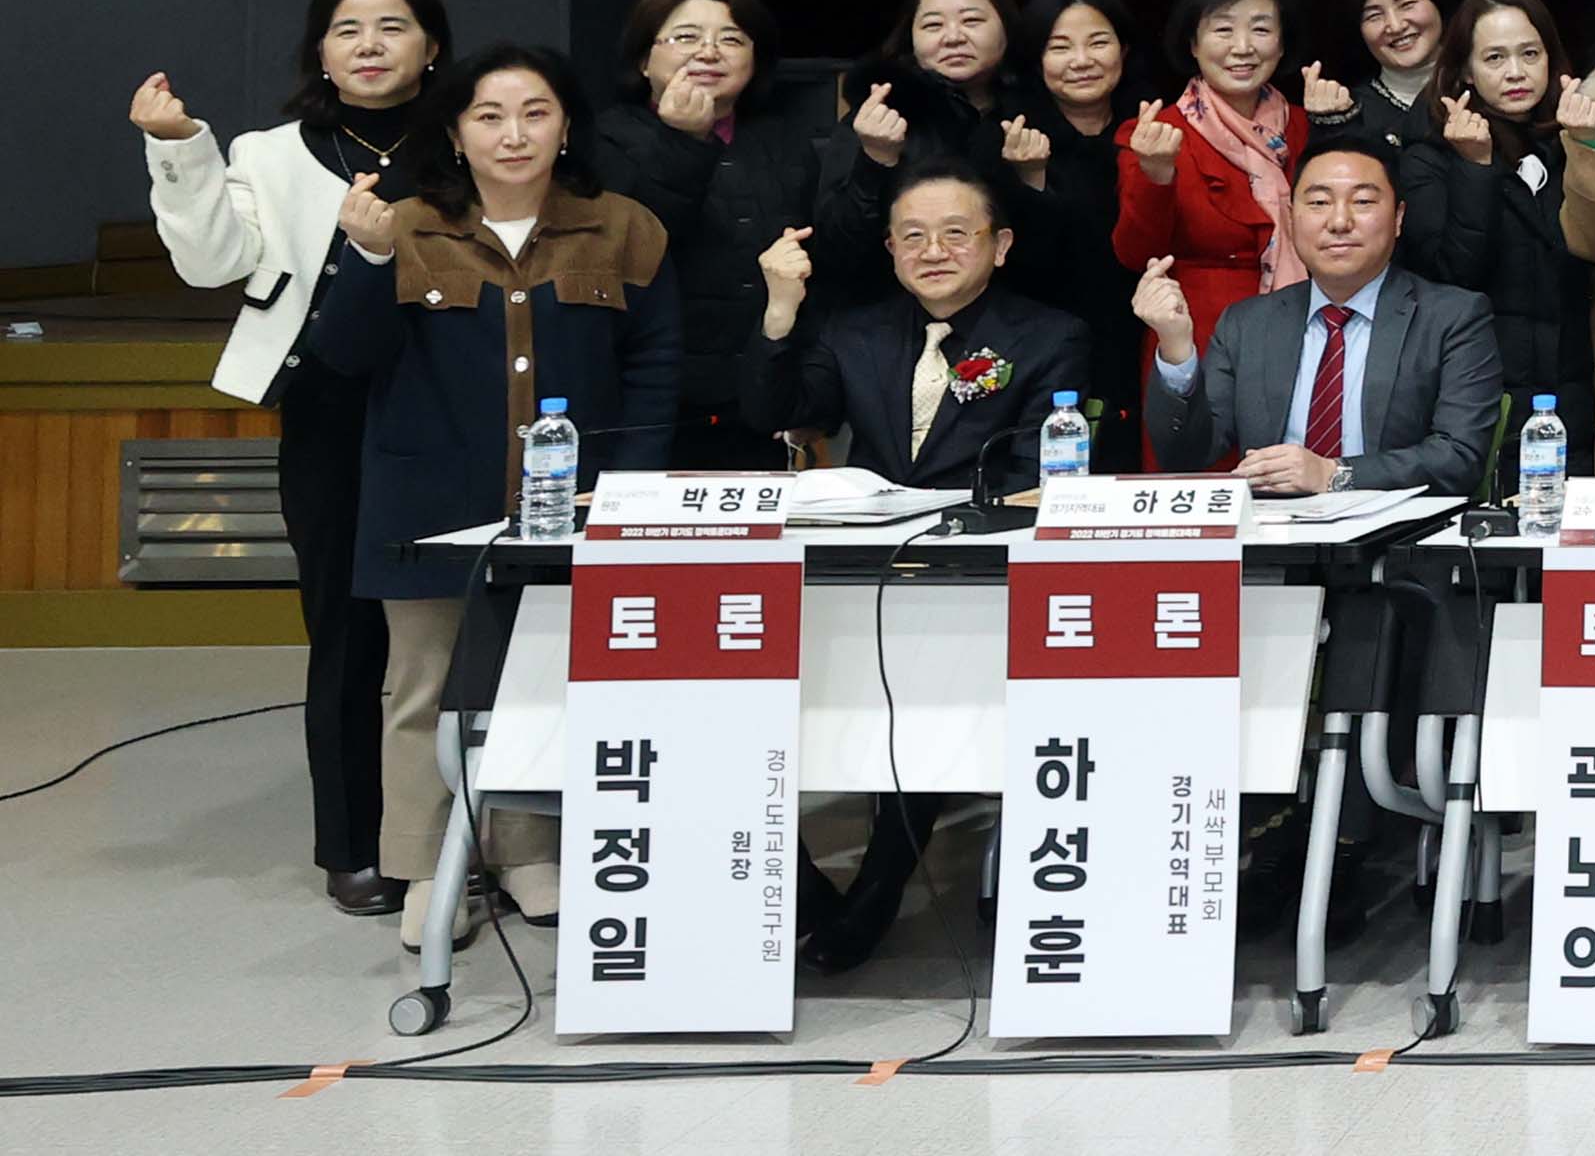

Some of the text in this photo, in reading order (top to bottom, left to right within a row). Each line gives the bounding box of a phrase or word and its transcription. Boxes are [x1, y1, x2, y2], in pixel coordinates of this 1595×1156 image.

[589, 739, 658, 981] 박정일
[731, 831, 751, 880] 원장
[762, 750, 785, 962] 경기도교육연구원
[1024, 738, 1095, 983] 하성훈
[1168, 776, 1191, 934] 경기지역대표
[1202, 789, 1226, 920] 새싹부모회
